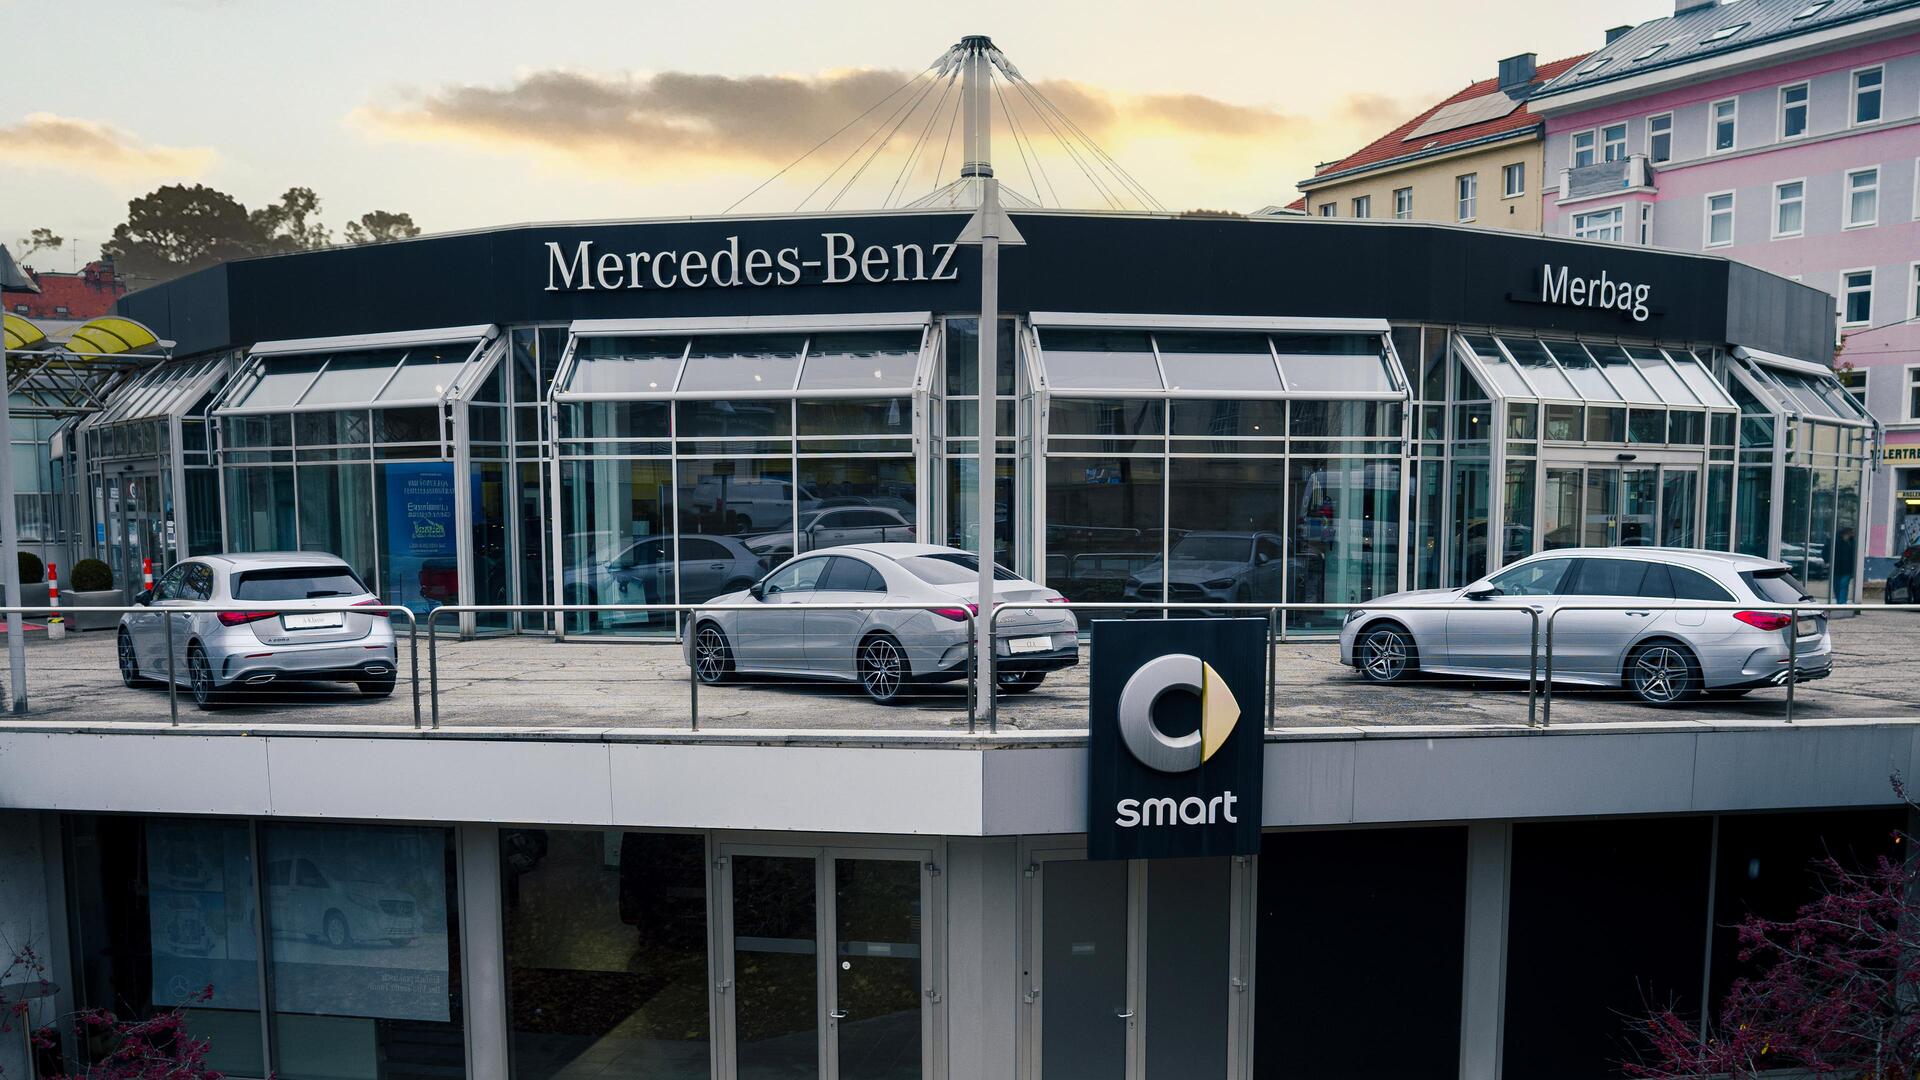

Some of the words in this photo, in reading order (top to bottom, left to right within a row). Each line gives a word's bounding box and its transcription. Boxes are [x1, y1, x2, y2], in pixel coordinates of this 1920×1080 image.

[544, 232, 959, 292] Mercedes-Benz
[1542, 264, 1650, 322] Merbag
[1870, 449, 1920, 460] LERTRE
[1115, 790, 1238, 828] smart
